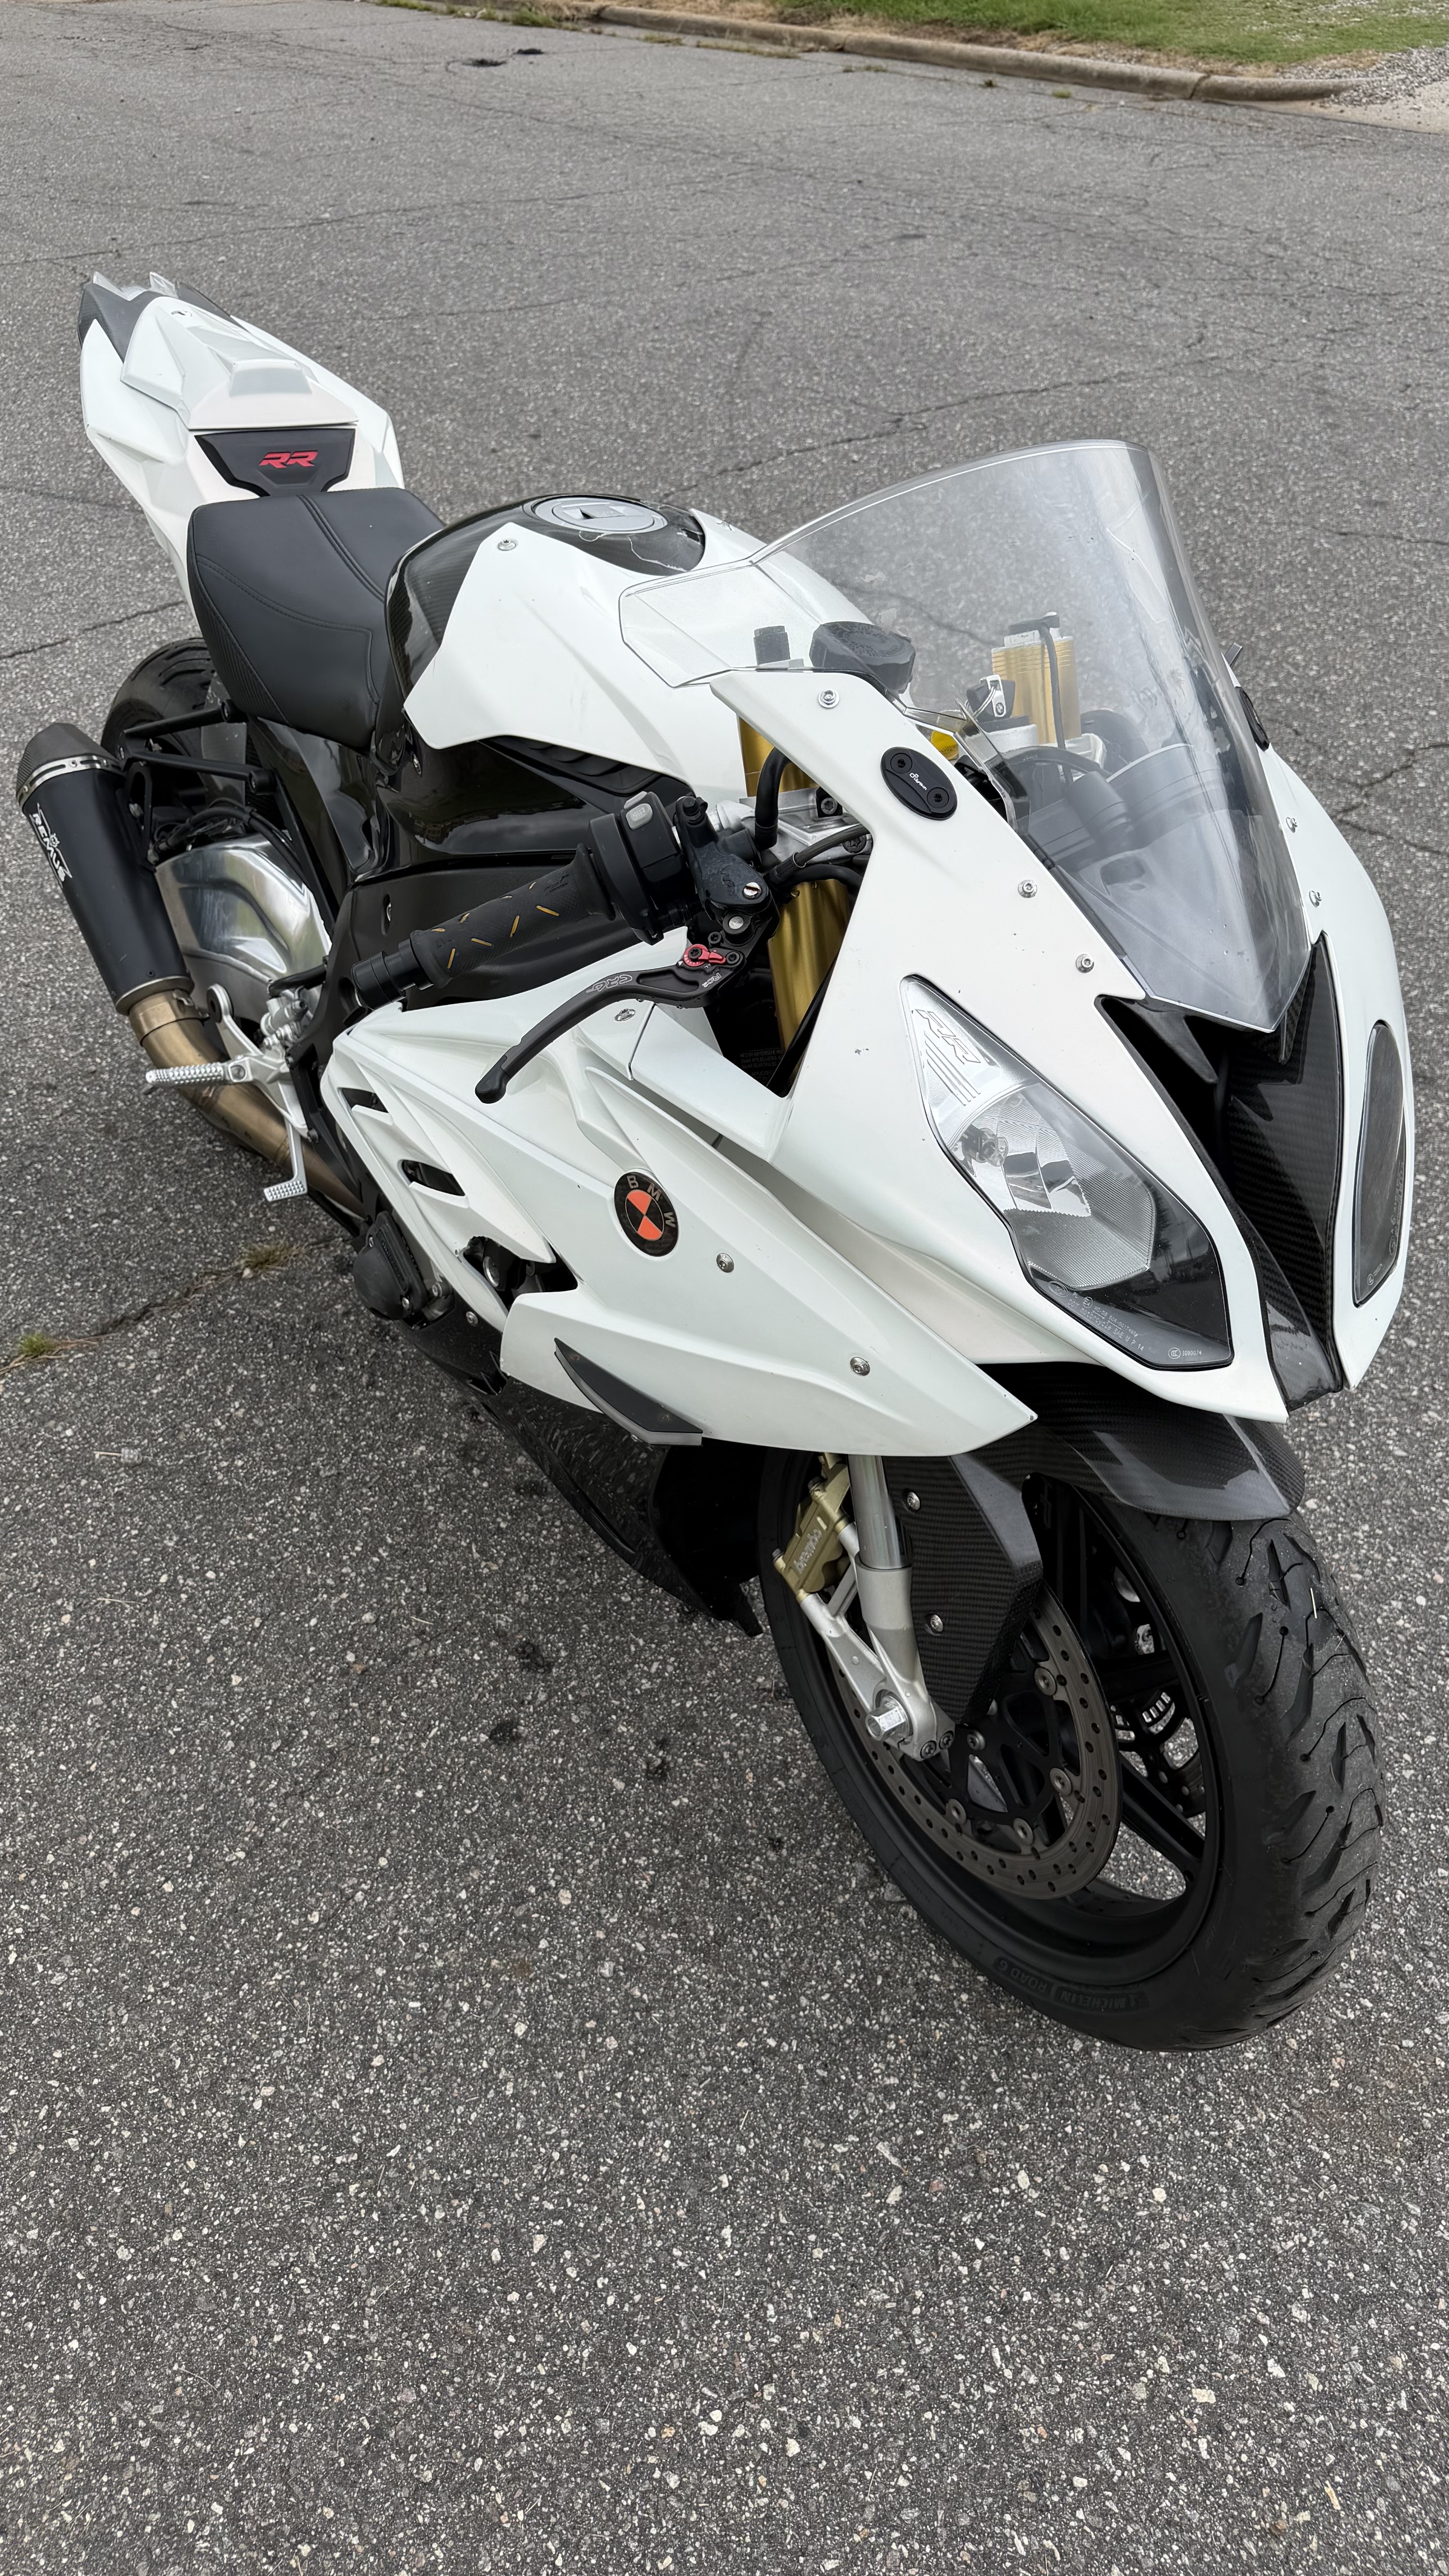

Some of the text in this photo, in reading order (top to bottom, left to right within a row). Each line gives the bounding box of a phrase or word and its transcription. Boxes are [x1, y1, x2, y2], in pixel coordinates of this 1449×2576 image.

[259, 451, 318, 469] RR
[586, 974, 633, 994] CRG
[915, 1009, 981, 1065] RR
[626, 1175, 676, 1228] BMW
[1067, 1299, 1079, 1309] DOT
[1081, 1308, 1111, 1331] motorcycle
[1113, 1328, 1124, 1339] SAE
[793, 1528, 822, 1575] brembo
[998, 1959, 1126, 2009] MICHELIN ROAD 6
